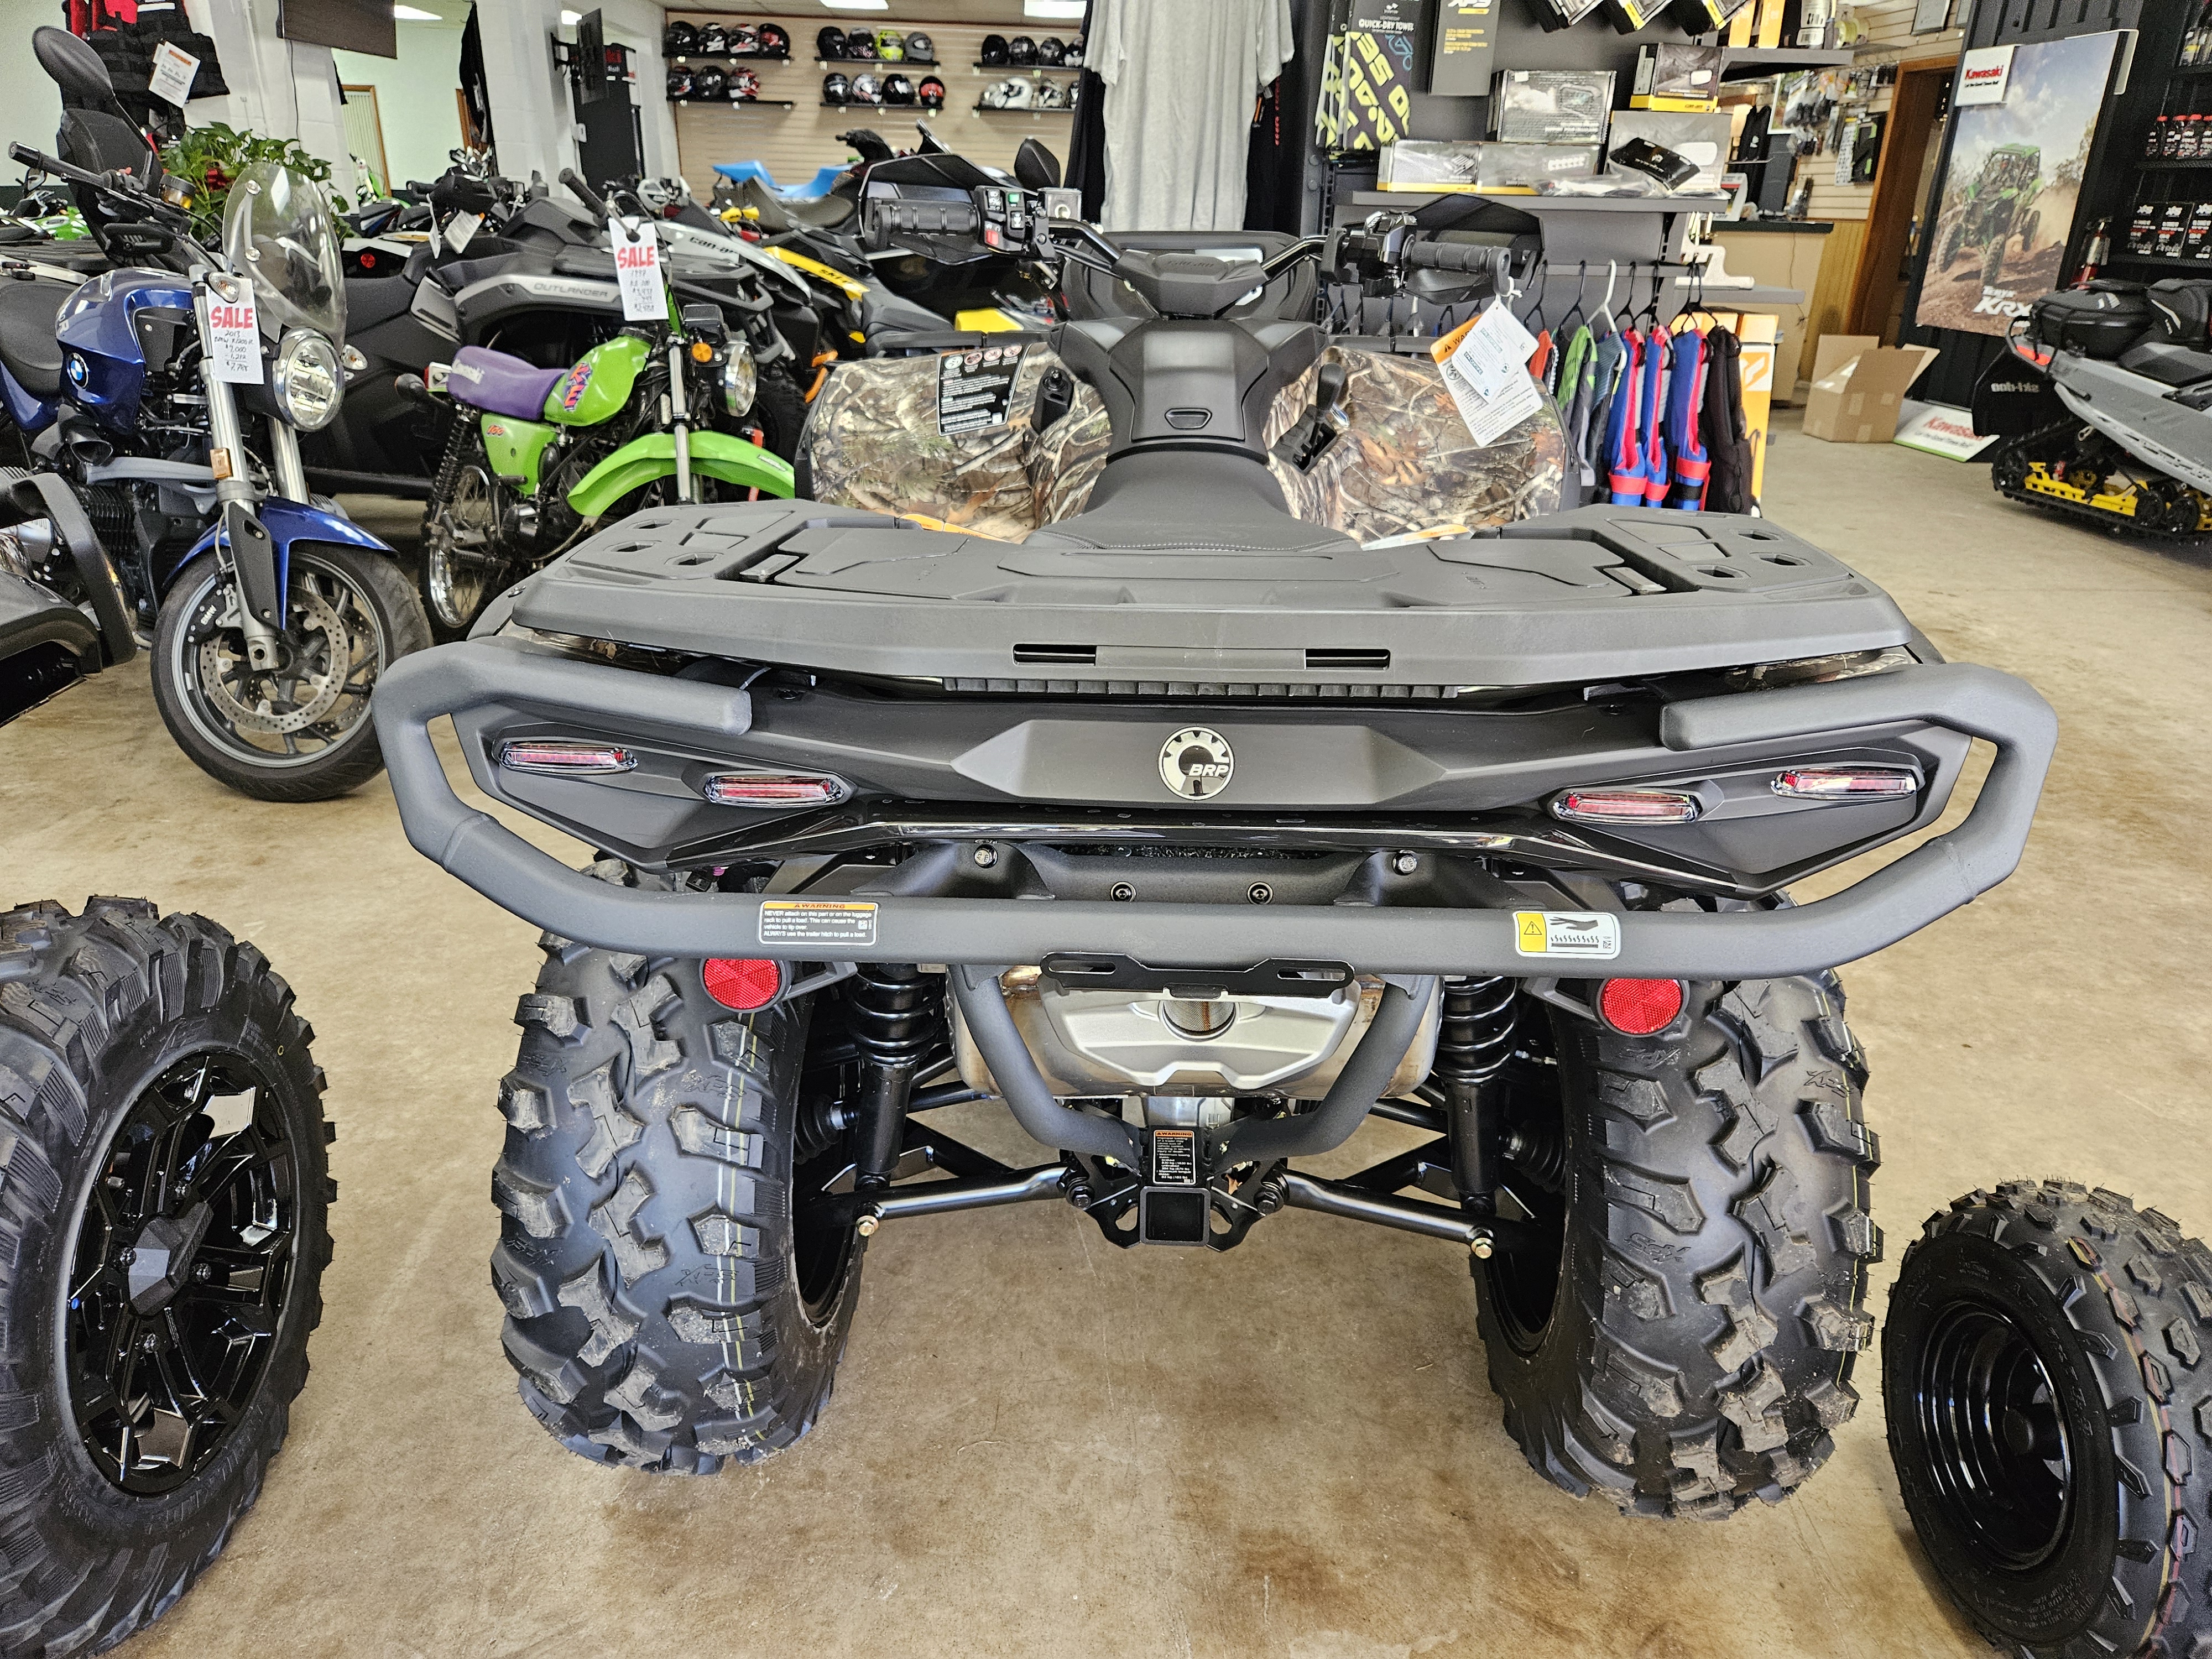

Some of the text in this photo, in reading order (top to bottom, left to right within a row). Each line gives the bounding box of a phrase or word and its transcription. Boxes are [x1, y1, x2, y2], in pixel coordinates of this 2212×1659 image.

[1965, 65, 2004, 80] Kawasaki
[617, 246, 655, 269] SALE
[534, 283, 608, 297] OUTLANDER
[211, 306, 253, 329] SALE
[487, 425, 505, 436] 100
[201, 604, 217, 625] BMW
[1189, 764, 1229, 777] BRP
